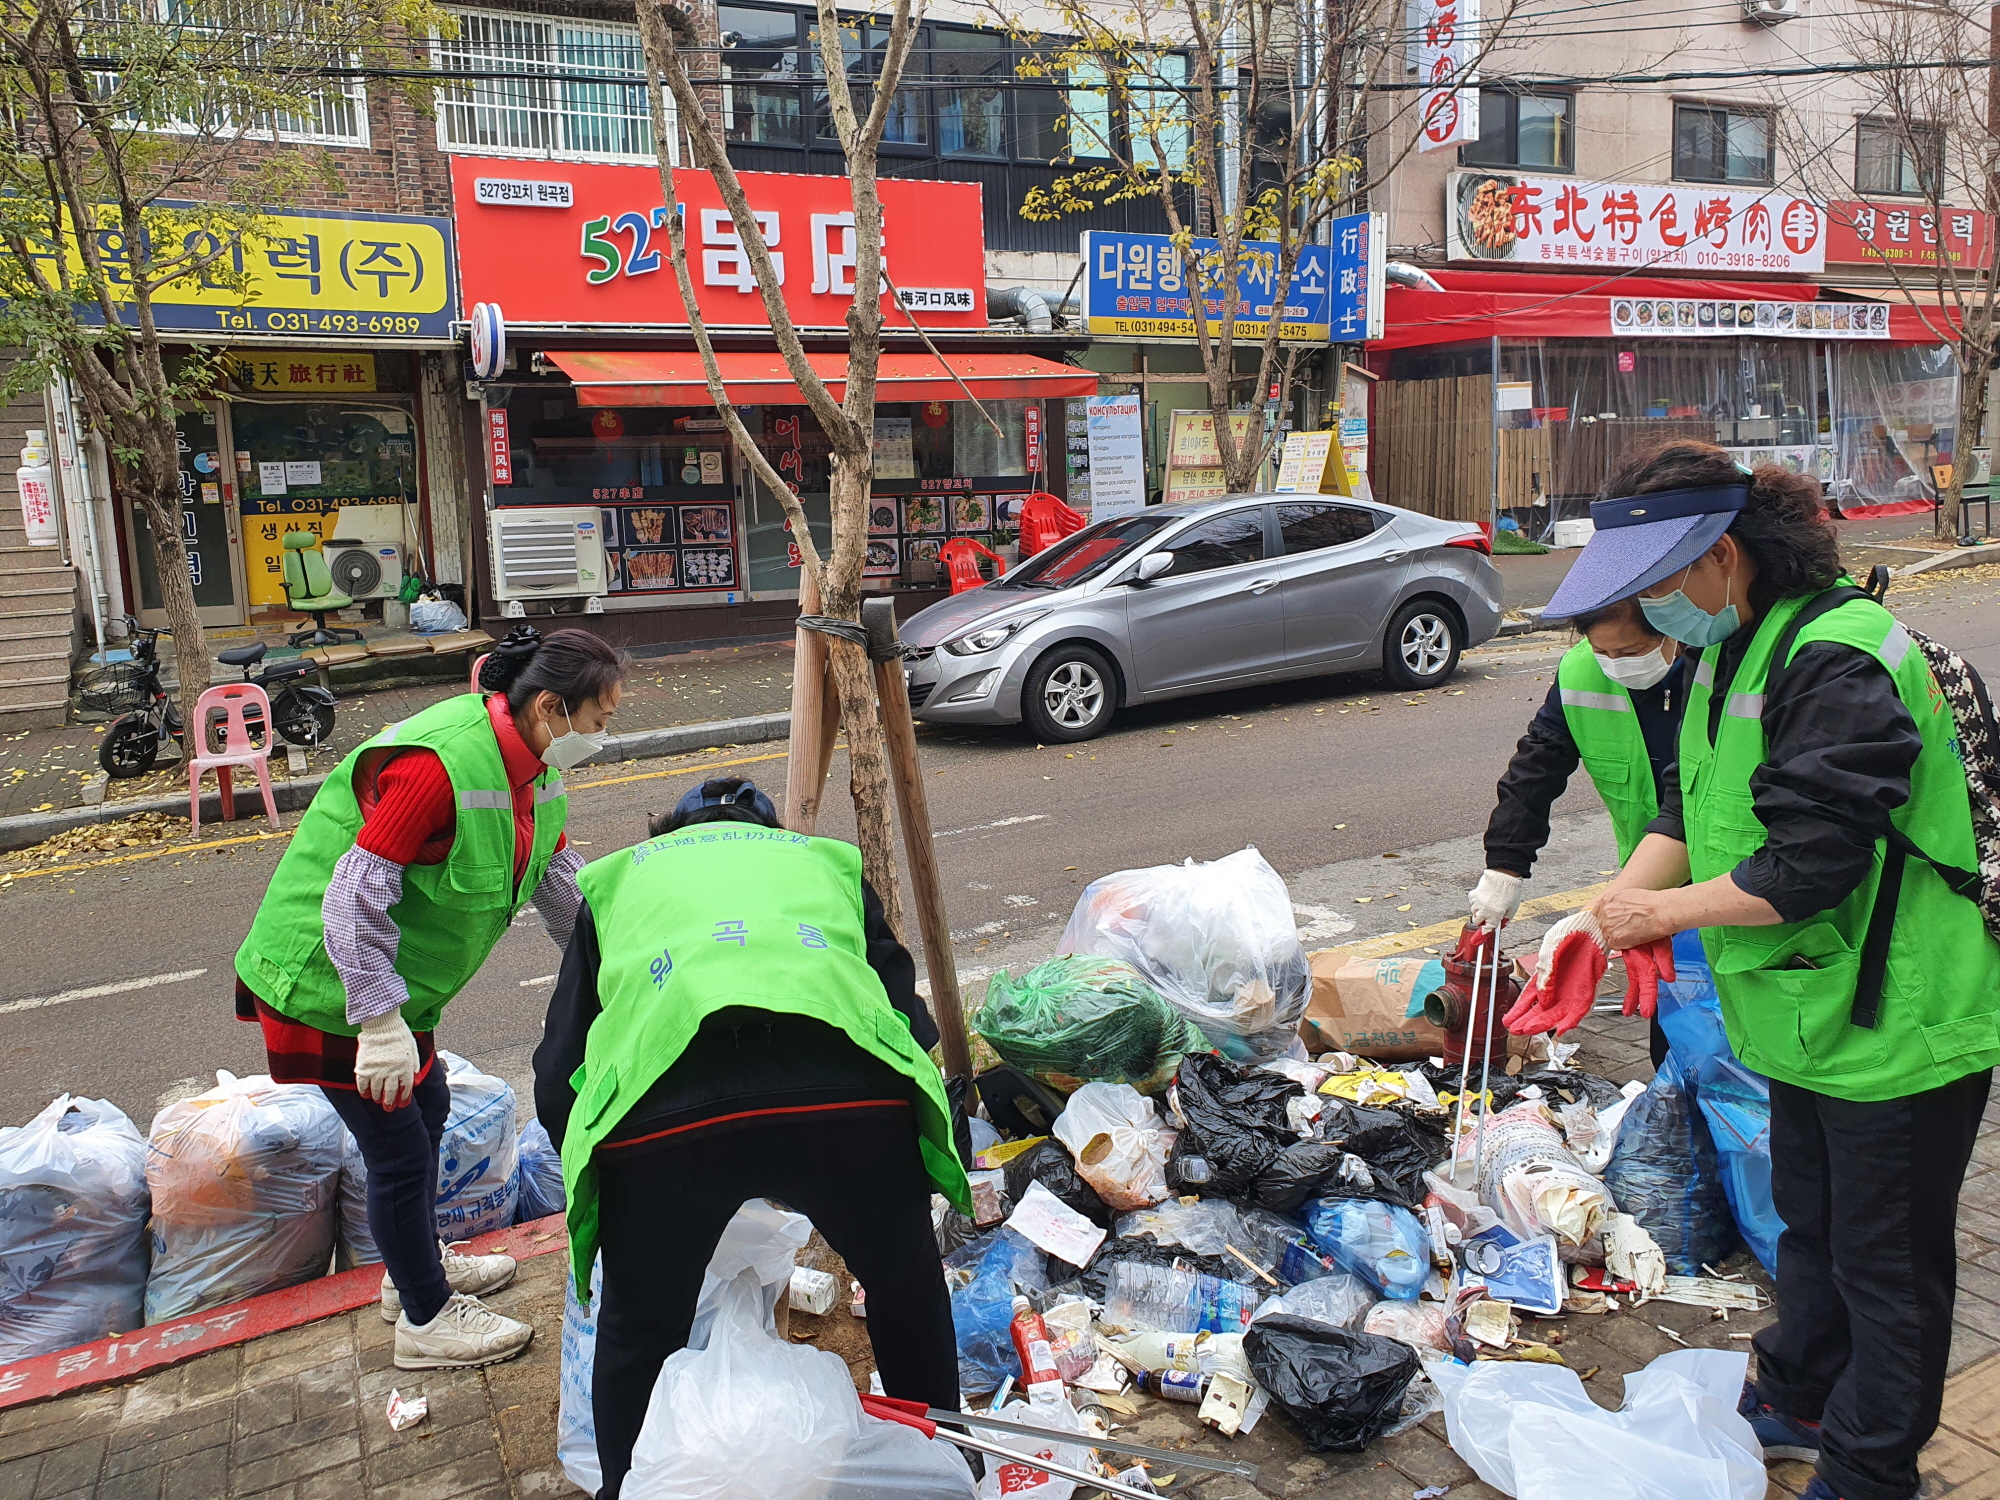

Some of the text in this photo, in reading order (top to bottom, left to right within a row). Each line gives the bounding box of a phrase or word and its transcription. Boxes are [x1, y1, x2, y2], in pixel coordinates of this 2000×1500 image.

[1426, 0, 1456, 139] 烤肉串
[480, 182, 570, 203] 527양꼬치 원곡점
[1853, 207, 1973, 247] 성원인력
[581, 202, 887, 295] 527 串店
[1697, 252, 1790, 267] 010-3918-8206
[1340, 228, 1357, 334] 行政士
[900, 290, 971, 308] 梅河口风味
[1116, 296, 1151, 311] 출입국
[1155, 297, 1193, 313] 업무대
[215, 310, 420, 334] Tel. 031-493-6989
[1115, 321, 1129, 332] TEL
[491, 412, 509, 481] 梅河口风味
[593, 487, 644, 500] 527串店
[921, 478, 973, 490] 527양꼬치
[257, 500, 285, 513] Tel.
[631, 831, 810, 866] 禁止随意乱扔垃圾
[1342, 1031, 1419, 1048] 고급전용분
